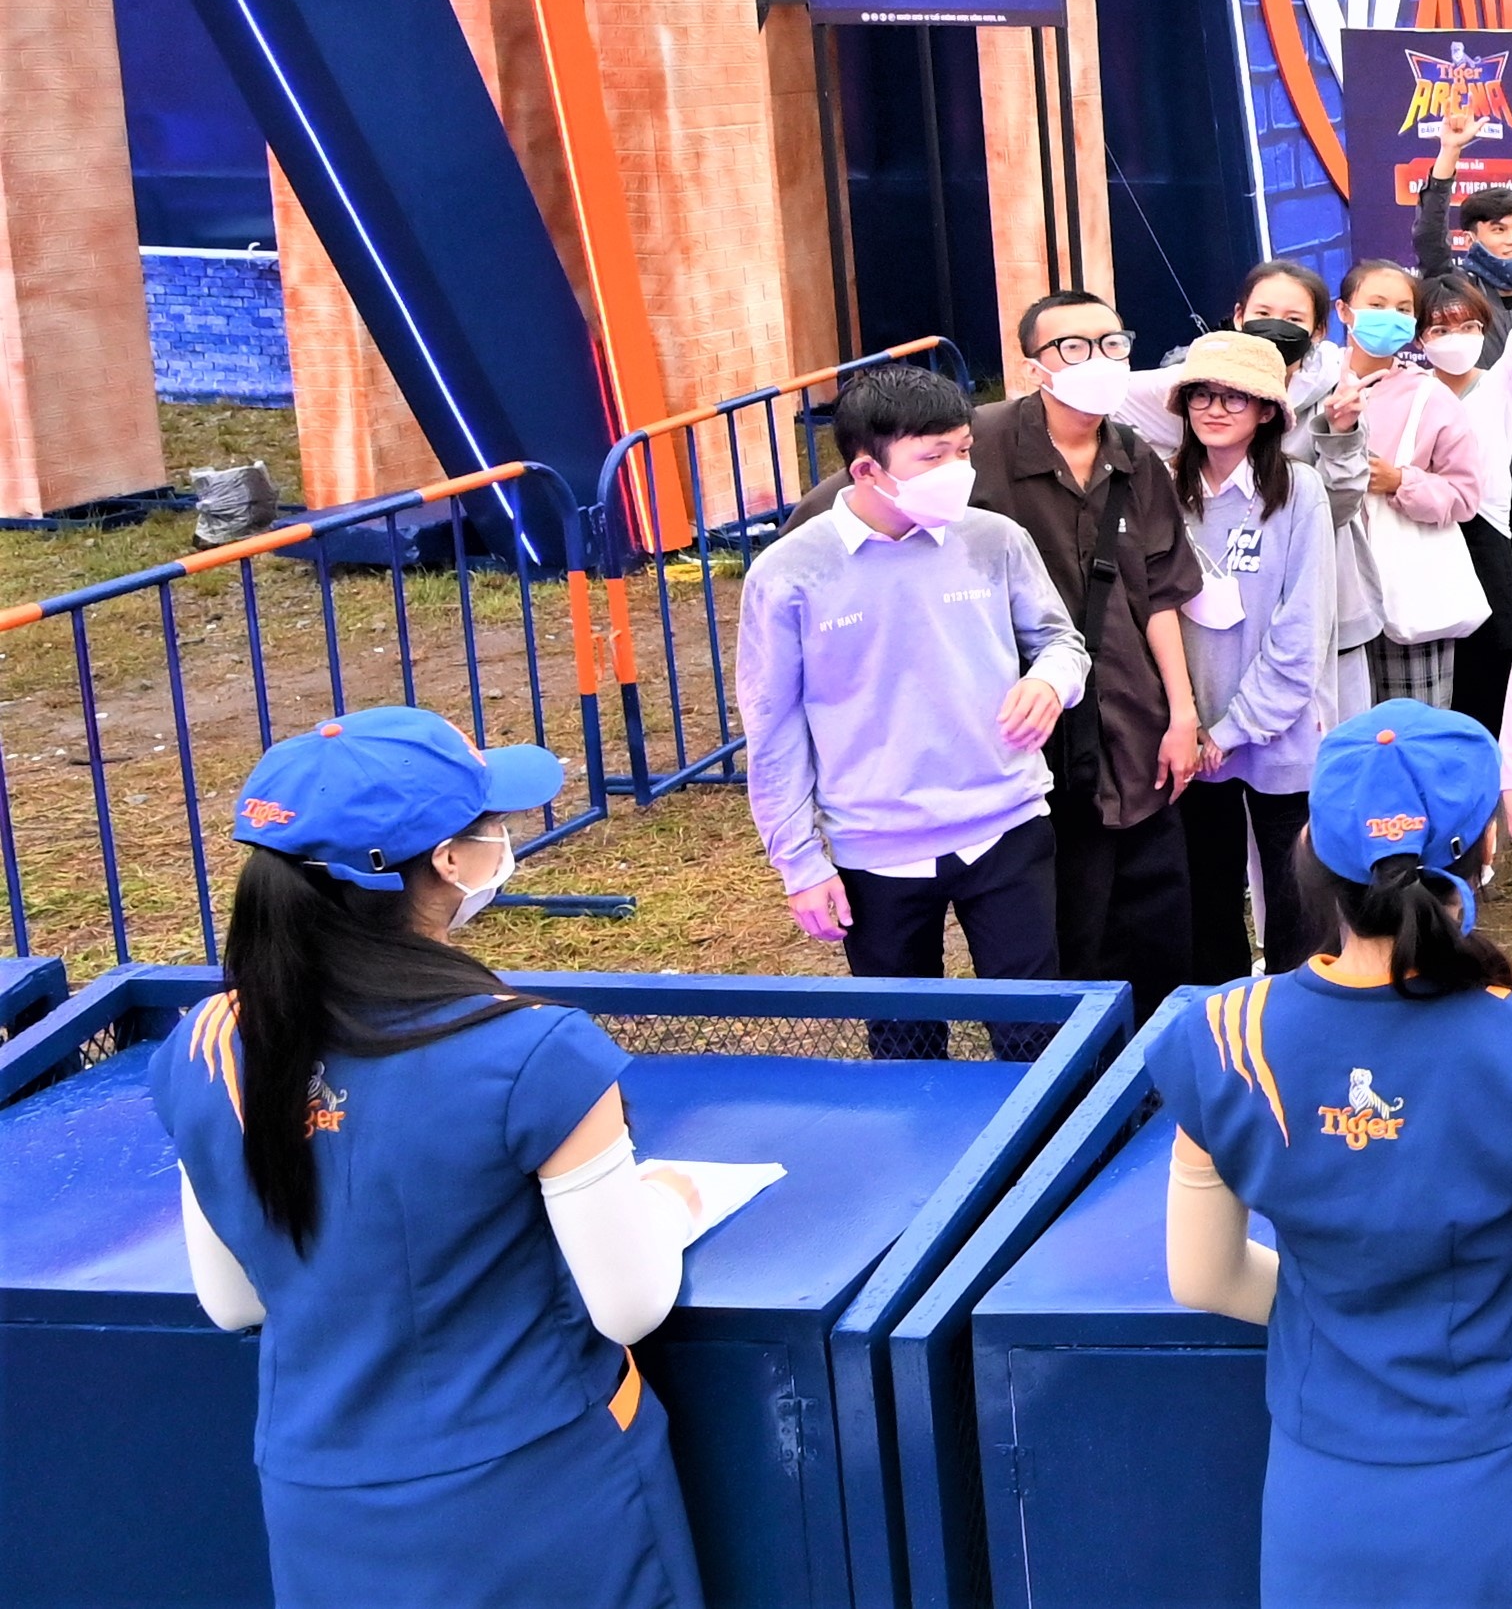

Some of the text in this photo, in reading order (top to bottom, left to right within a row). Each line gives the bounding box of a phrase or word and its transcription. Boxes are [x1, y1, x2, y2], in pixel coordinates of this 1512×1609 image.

[1436, 63, 1483, 87] Tiger
[943, 589, 992, 603] 01312014
[837, 611, 864, 629] NAVY
[241, 797, 295, 827] Tiger
[1366, 813, 1426, 842] Tiger
[1318, 1105, 1404, 1150] Tiger
